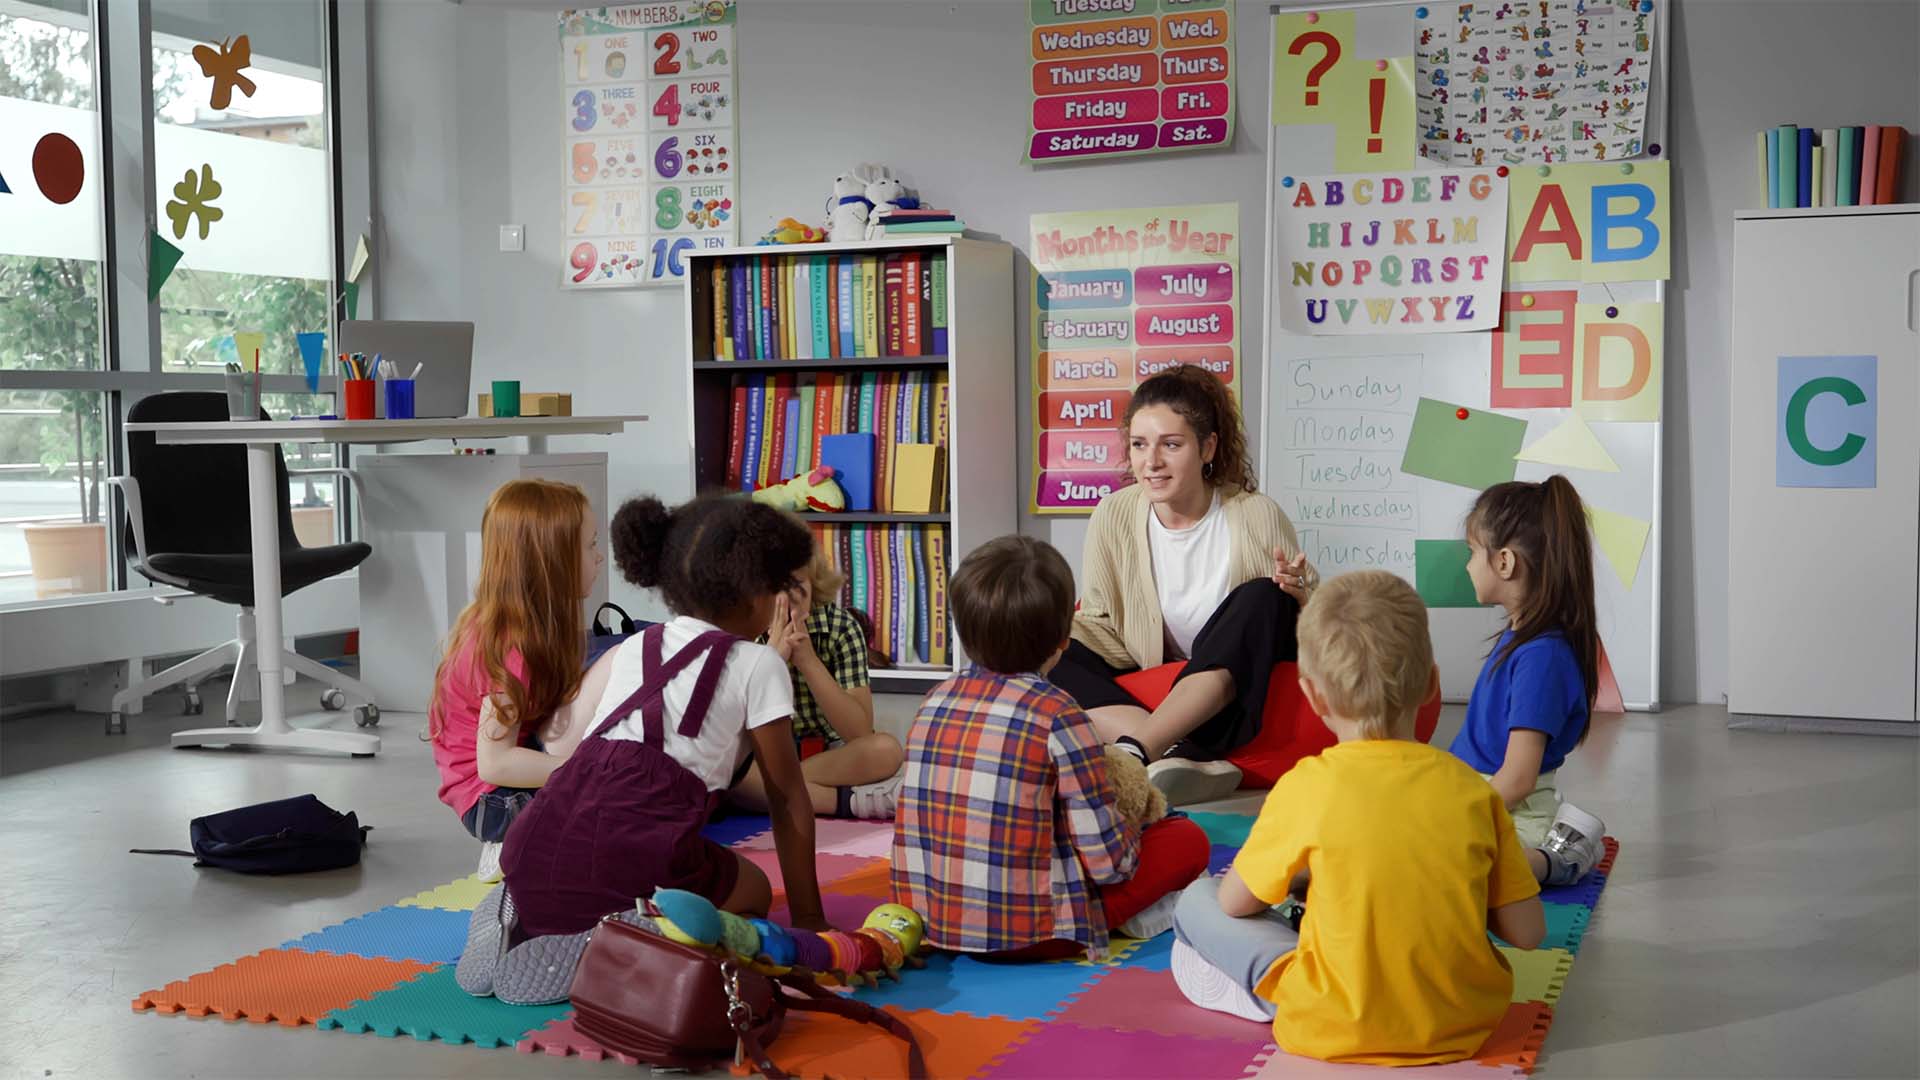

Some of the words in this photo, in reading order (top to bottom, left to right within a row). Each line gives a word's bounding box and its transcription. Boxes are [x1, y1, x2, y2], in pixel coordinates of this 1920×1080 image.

[615, 6, 679, 25] NUMBERS
[1040, 27, 1151, 50] Wednesday
[1168, 18, 1219, 39] Wed.
[574, 45, 590, 80] 1
[604, 38, 629, 49] ONE
[654, 32, 682, 75] 2
[692, 31, 718, 42] TWO
[1050, 63, 1142, 85] Thursday
[1163, 57, 1225, 75] Thurs.
[572, 90, 598, 131] 3
[603, 88, 636, 99] THREE
[653, 84, 682, 126] 4
[690, 82, 720, 94] FOUR
[1064, 100, 1127, 119] Friday
[1177, 92, 1211, 110] Fri.
[1049, 132, 1139, 152] Saturday
[1172, 123, 1212, 141] Sat.
[572, 142, 598, 184] 5
[655, 136, 683, 178] 6
[695, 135, 716, 146] SIX
[572, 192, 598, 233] 7
[655, 186, 683, 230] 8
[690, 185, 724, 197] EIGHT
[703, 238, 725, 249] TEN
[1036, 225, 1139, 262] Months
[1145, 217, 1160, 231] of
[1167, 219, 1234, 254] Year
[571, 242, 598, 283] 9
[608, 241, 637, 252] NINE
[906, 261, 916, 295] WORLD
[922, 269, 930, 301] LAW
[1046, 279, 1124, 300] January
[1160, 274, 1207, 296] July
[906, 302, 916, 345] HISTORY
[1043, 319, 1129, 340] February
[1148, 313, 1220, 336] August
[1054, 358, 1117, 379] March
[1582, 323, 1651, 400] D
[1294, 360, 1402, 408] Sunday
[1060, 399, 1112, 425] April
[1785, 376, 1867, 466] C
[1293, 416, 1394, 446] Monday
[1065, 441, 1108, 464] May
[1296, 454, 1393, 489] Tuesday
[1058, 481, 1111, 501] June
[1296, 496, 1414, 522] Wednesday
[933, 537, 944, 649] PHYSICS
